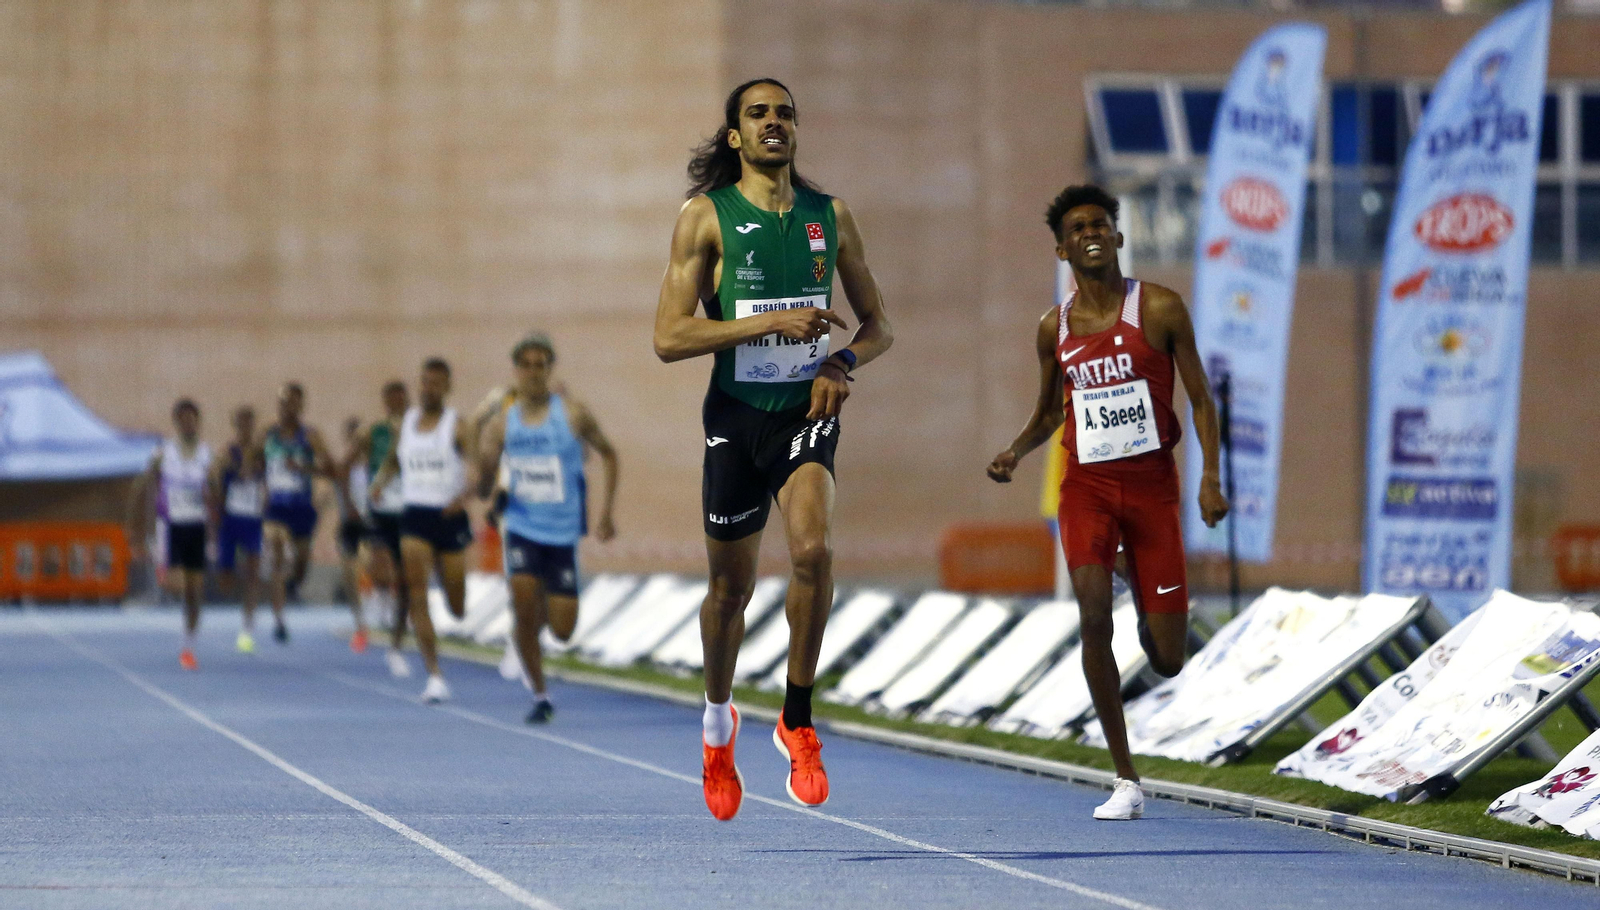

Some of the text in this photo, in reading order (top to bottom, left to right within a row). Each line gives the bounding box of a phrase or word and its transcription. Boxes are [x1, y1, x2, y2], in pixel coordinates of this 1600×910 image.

[752, 302, 787, 313] DESAFÍO
[809, 345, 818, 358] 2
[1066, 353, 1135, 390] QATAR
[1083, 386, 1135, 401] DESAFÍO NERJA
[1085, 398, 1147, 431] A. Saeed
[1138, 422, 1146, 434] 5
